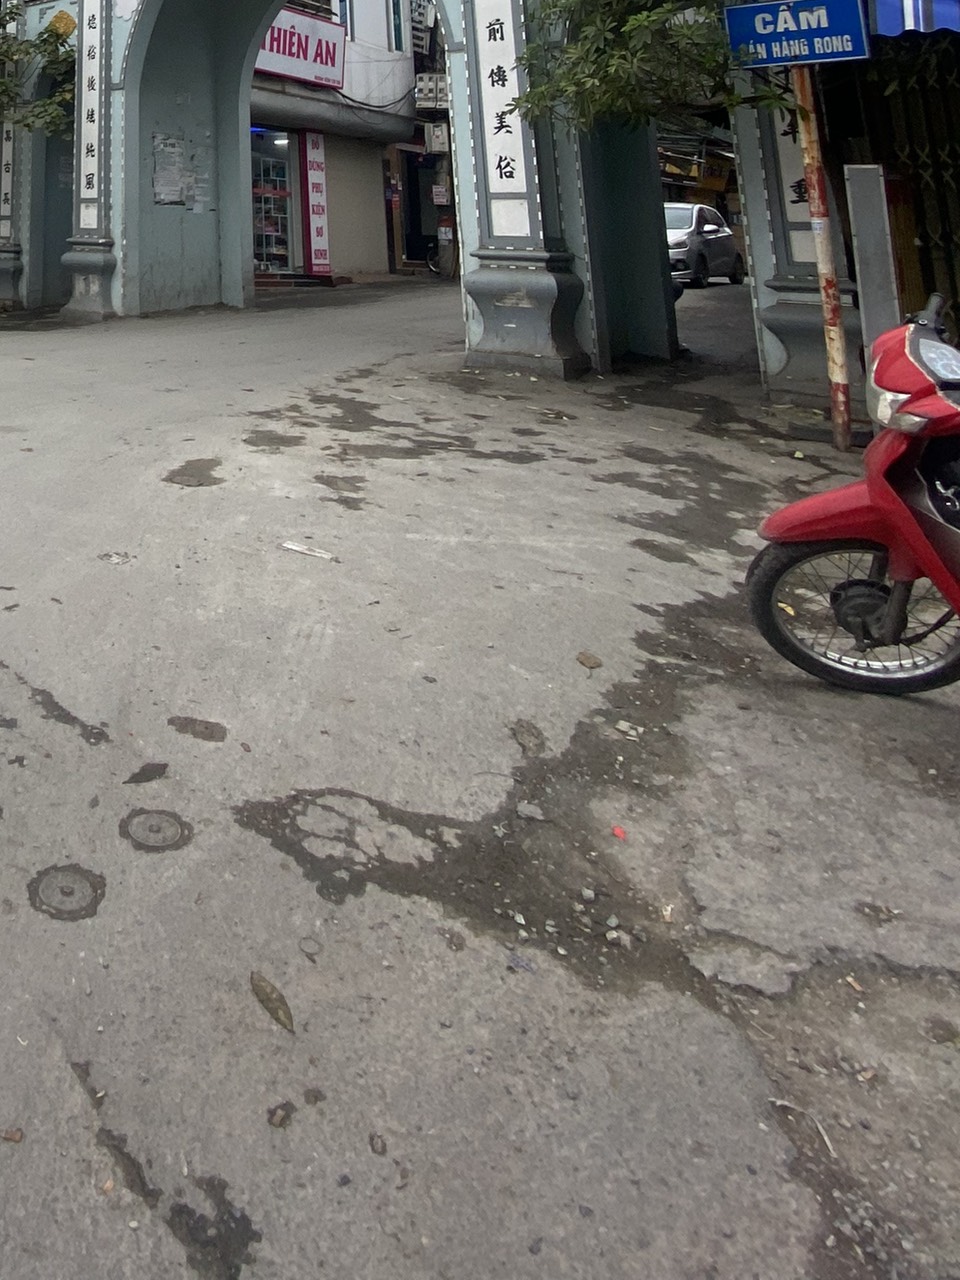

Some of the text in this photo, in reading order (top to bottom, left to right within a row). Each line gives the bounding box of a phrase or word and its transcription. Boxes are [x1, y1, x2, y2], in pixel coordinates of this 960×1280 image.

[755, 2, 828, 34] CẤM
[313, 38, 337, 67] AN
[747, 35, 853, 59] ÁN HÀNG RONG
